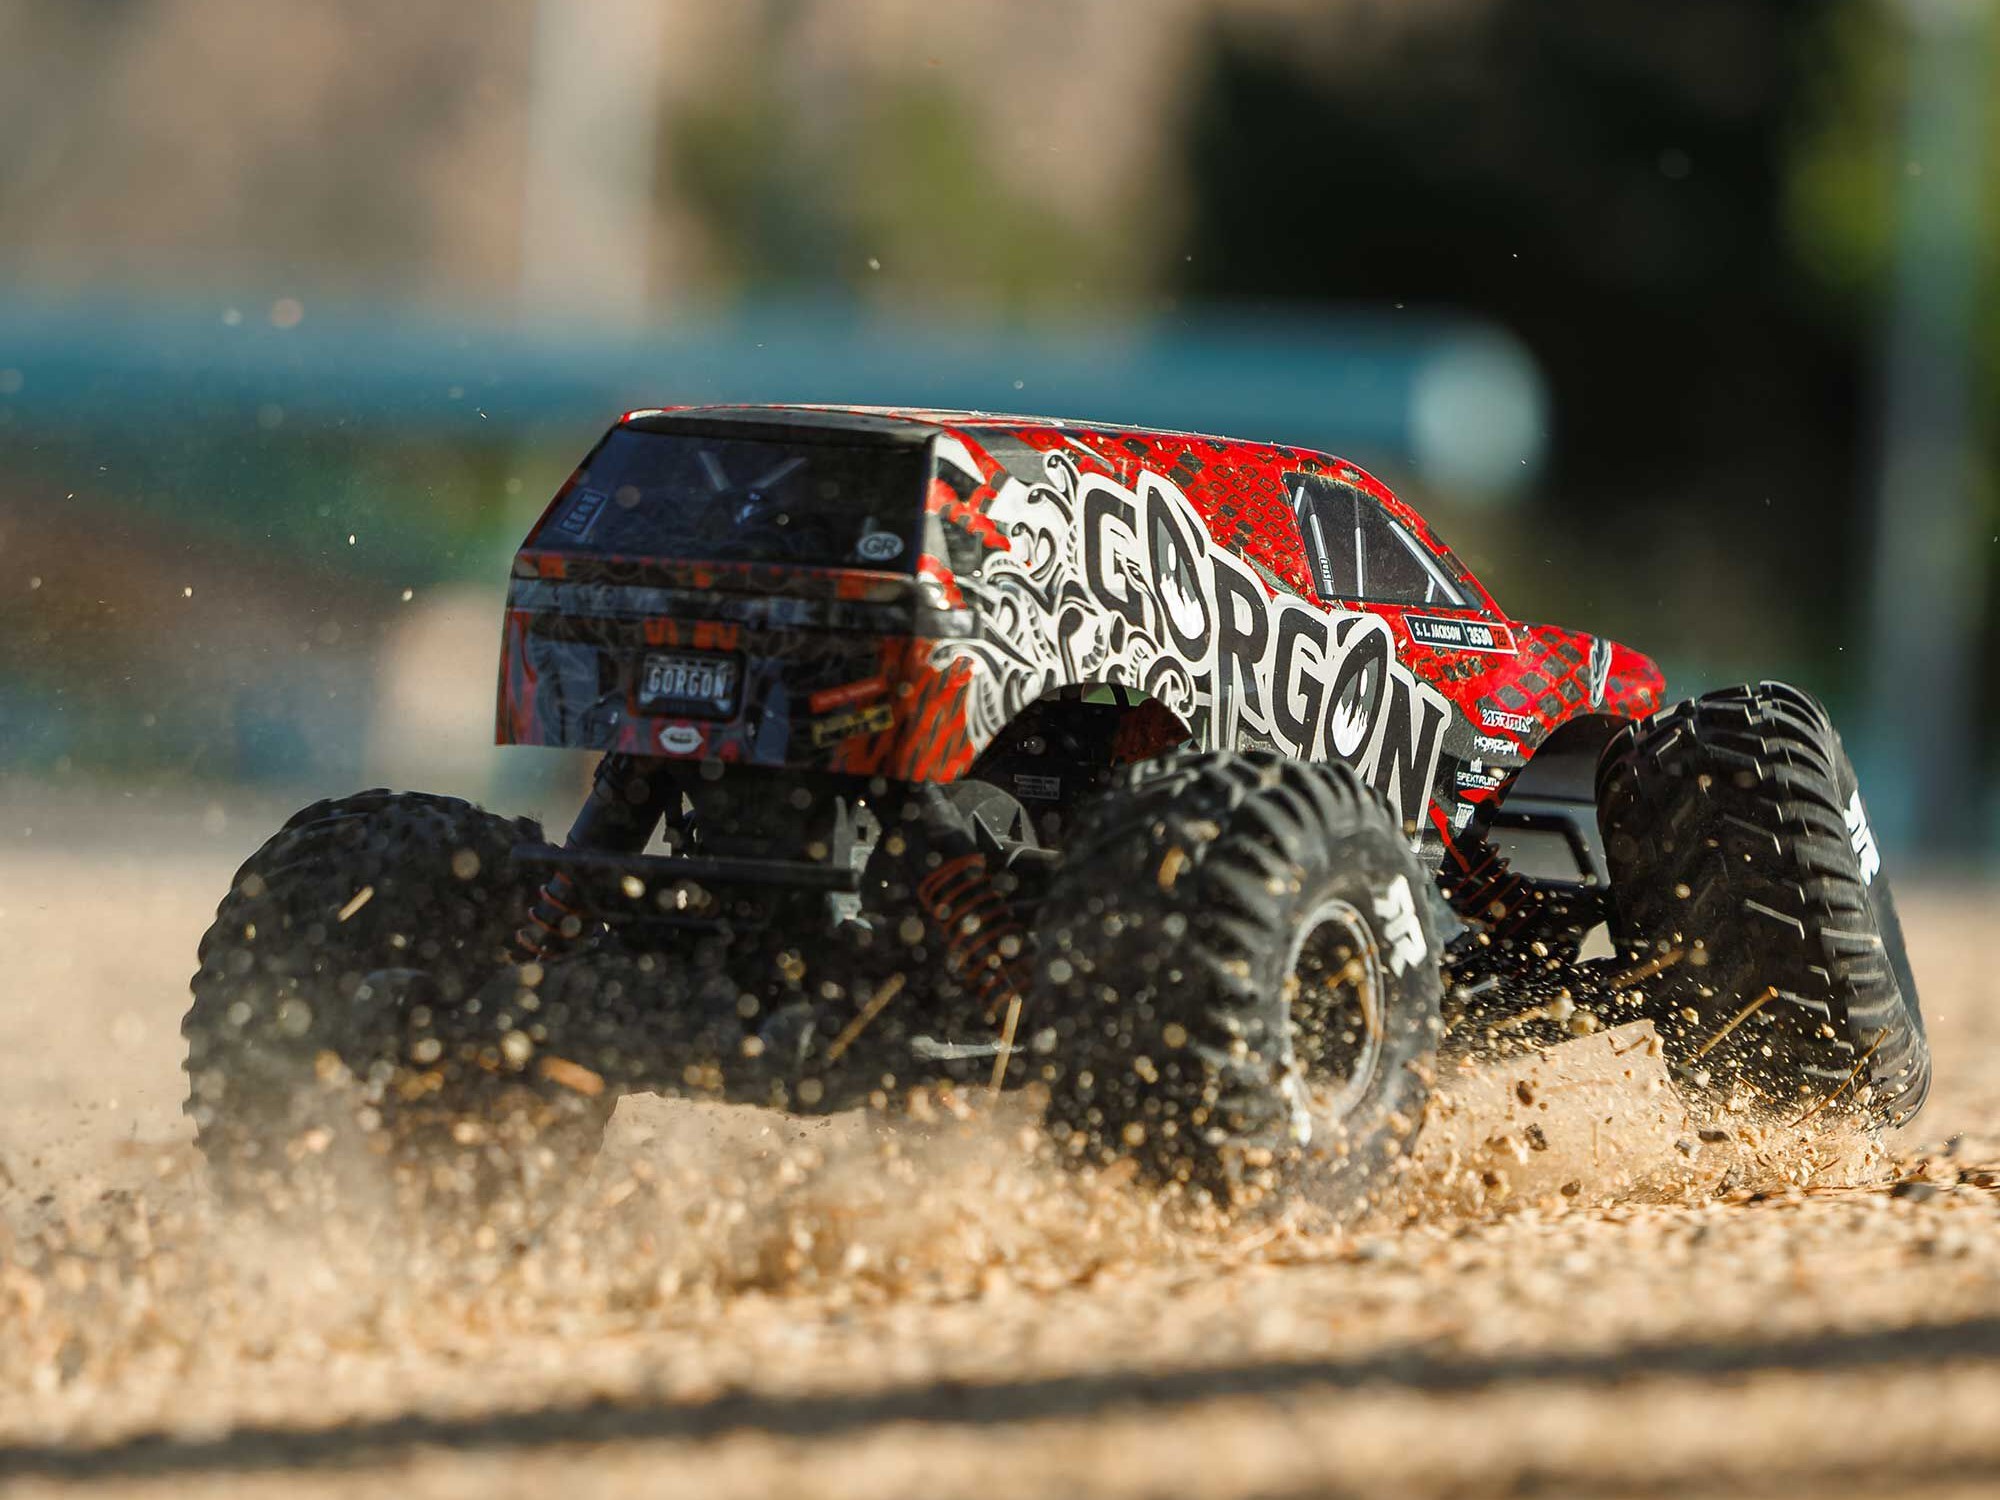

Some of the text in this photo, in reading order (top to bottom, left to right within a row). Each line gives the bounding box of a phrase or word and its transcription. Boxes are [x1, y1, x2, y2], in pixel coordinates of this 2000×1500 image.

[864, 536, 898, 558] GR
[1431, 623, 1462, 641] JACKSON
[1083, 478, 1449, 846] GORGON
[648, 666, 727, 699] GORGON
[1473, 735, 1519, 756] HORIZON
[1456, 771, 1500, 787] SPEKTRUM
